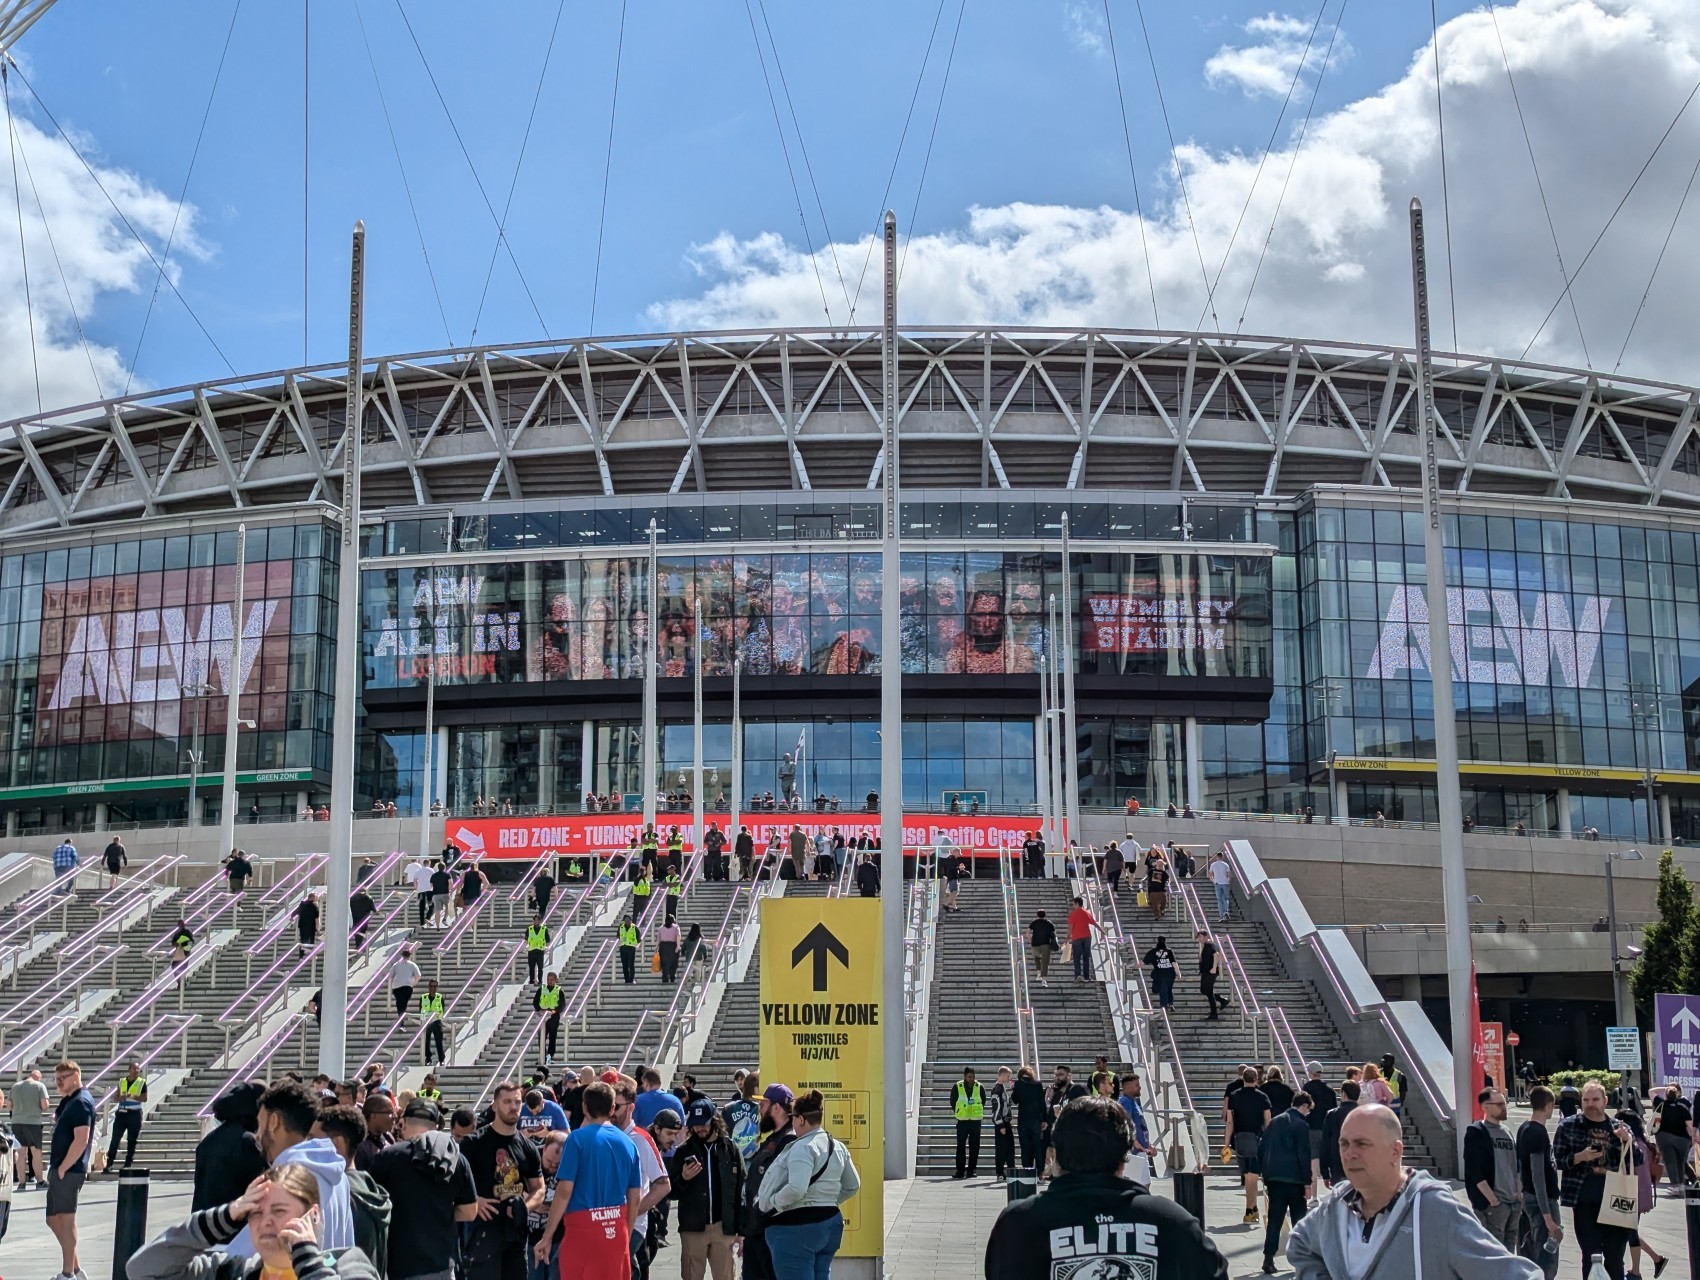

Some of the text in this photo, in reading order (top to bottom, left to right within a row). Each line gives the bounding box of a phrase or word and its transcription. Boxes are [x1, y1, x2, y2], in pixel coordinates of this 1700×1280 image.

[412, 576, 486, 607] AEW
[1088, 599, 1234, 624] WEMBLEY
[374, 611, 521, 657] ALL IN
[1098, 626, 1225, 650] STADIUM
[1366, 585, 1612, 688] AEW
[48, 600, 279, 709] AEW
[1368, 761, 1389, 769] ZONE
[1553, 768, 1581, 776] YELLOW
[256, 772, 299, 782] GREEN ZONE
[67, 784, 105, 794] GREEN ZONE
[499, 828, 529, 848] RED
[531, 826, 570, 847] ZONE
[584, 824, 678, 846] TURNSTES
[929, 825, 985, 847] Pacific
[762, 1003, 879, 1026] YELLOW ZONE
[792, 1032, 849, 1046] TURNSTILES
[800, 1047, 840, 1061] H/J/K/L
[1673, 1057, 1699, 1071] ZONE
[808, 1081, 843, 1089] RESTRICTIONS
[521, 1118, 553, 1128] ALL IN
[1611, 1197, 1636, 1211] AEW
[591, 1208, 621, 1222] KLINIK
[1094, 1213, 1115, 1224] the
[1049, 1222, 1159, 1259] ELITE
